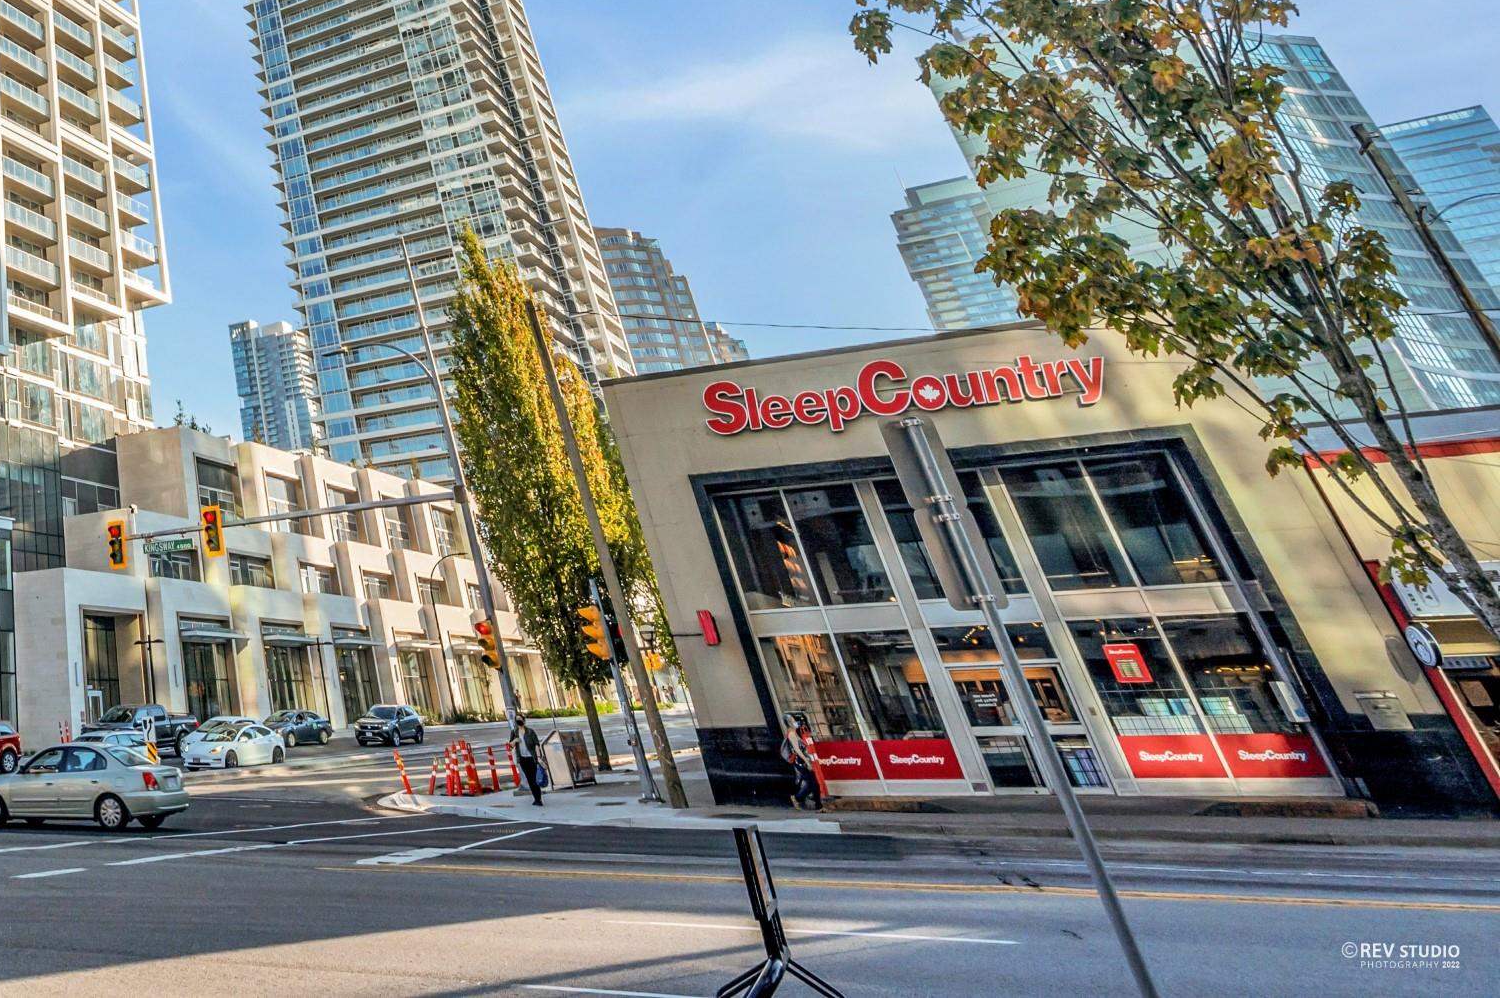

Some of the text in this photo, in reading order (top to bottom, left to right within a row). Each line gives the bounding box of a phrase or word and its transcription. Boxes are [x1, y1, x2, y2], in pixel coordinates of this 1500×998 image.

[702, 355, 1105, 436] SleepCountry
[145, 541, 175, 553] KINGSWAY
[819, 755, 861, 766] eepCountry
